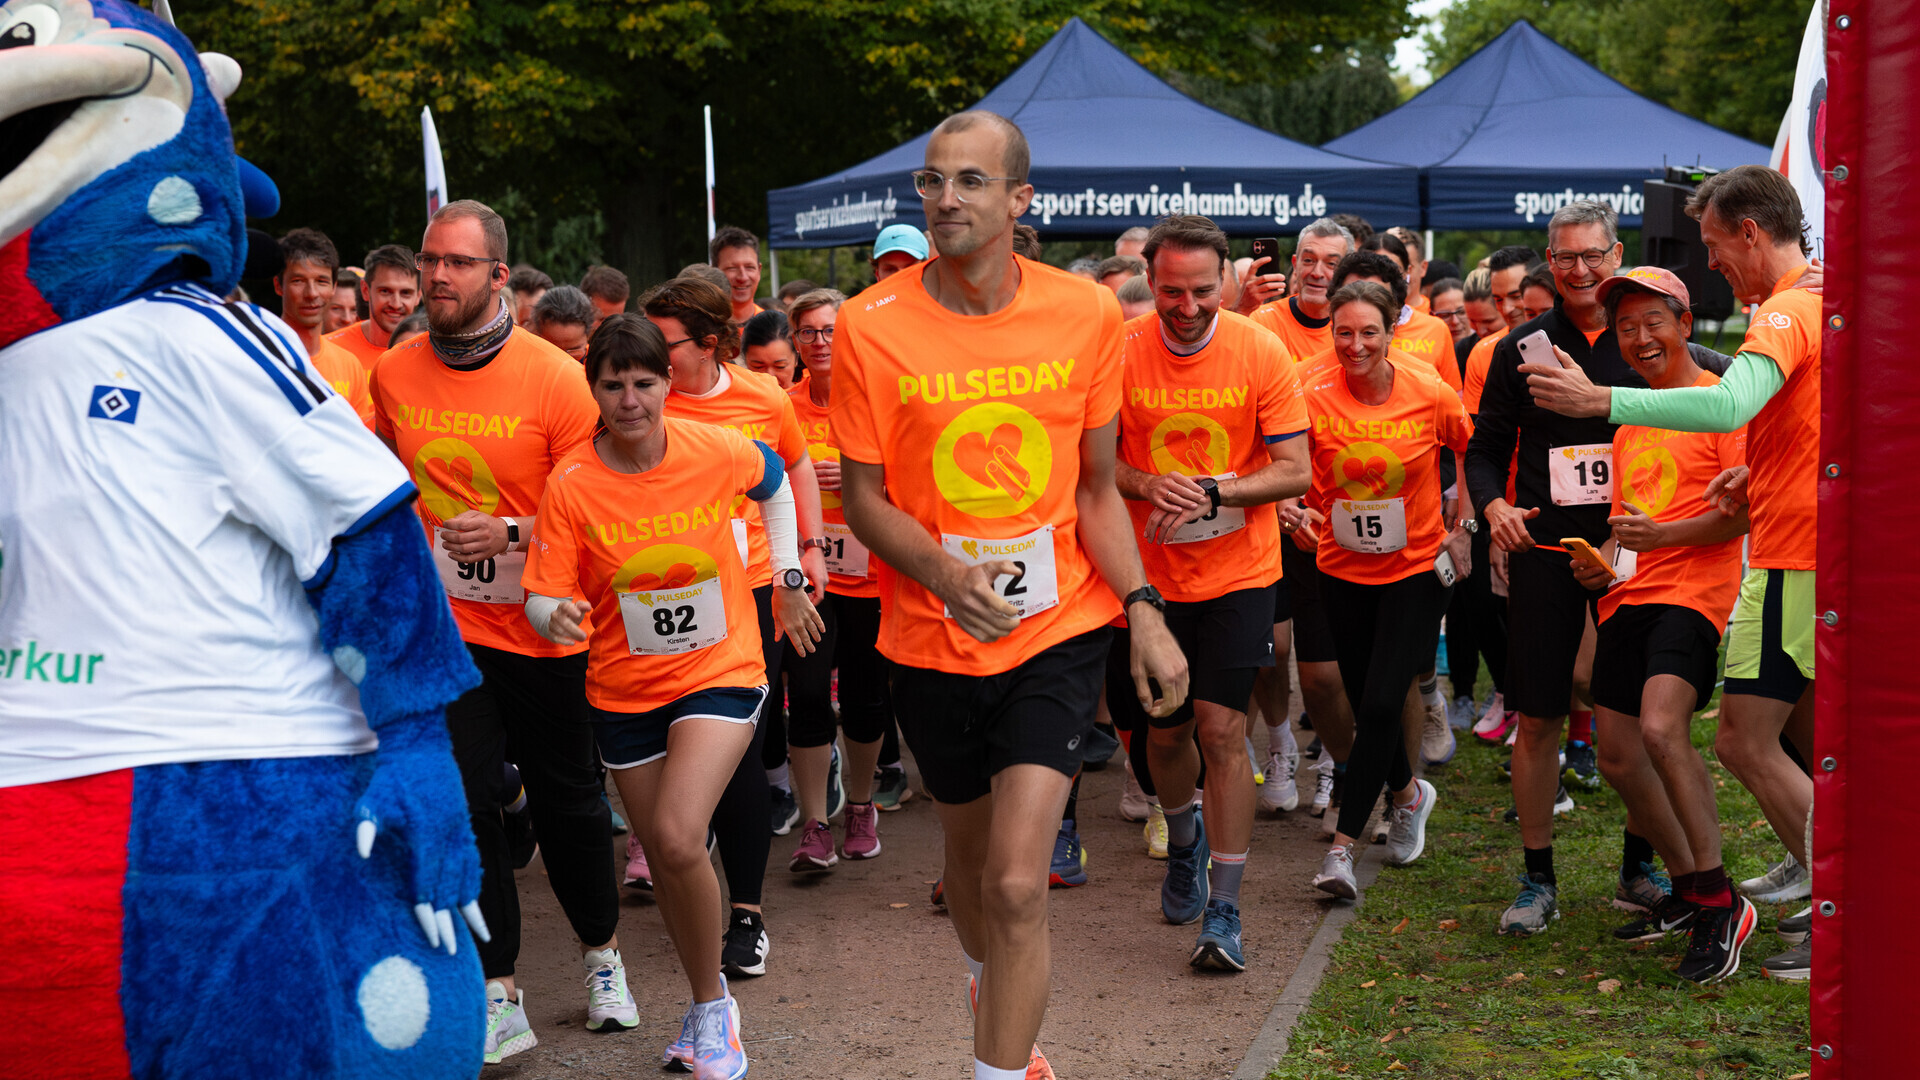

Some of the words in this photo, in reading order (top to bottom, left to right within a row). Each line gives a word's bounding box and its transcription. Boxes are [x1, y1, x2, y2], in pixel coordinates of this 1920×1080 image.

[795, 187, 897, 240] sportservicehamburg.de
[1030, 182, 1327, 225] sportservicehamburg.de
[876, 294, 897, 308] JAKO
[898, 358, 1075, 405] PULSEDAY
[1131, 385, 1249, 410] PULSEDAY
[397, 404, 522, 439] PULSEDAY
[1316, 415, 1426, 440] PULSEDAY
[564, 463, 582, 476] JAKO
[1574, 460, 1609, 486] 19
[1354, 503, 1390, 511] PULSEDAY
[585, 499, 721, 546] PULSEDAY
[1351, 515, 1383, 538] 15
[982, 538, 1037, 555] PULSEDAY
[457, 556, 496, 583] 90
[656, 587, 704, 602] PULSEDAY
[652, 605, 698, 636] 82
[666, 636, 690, 645] Kirsten
